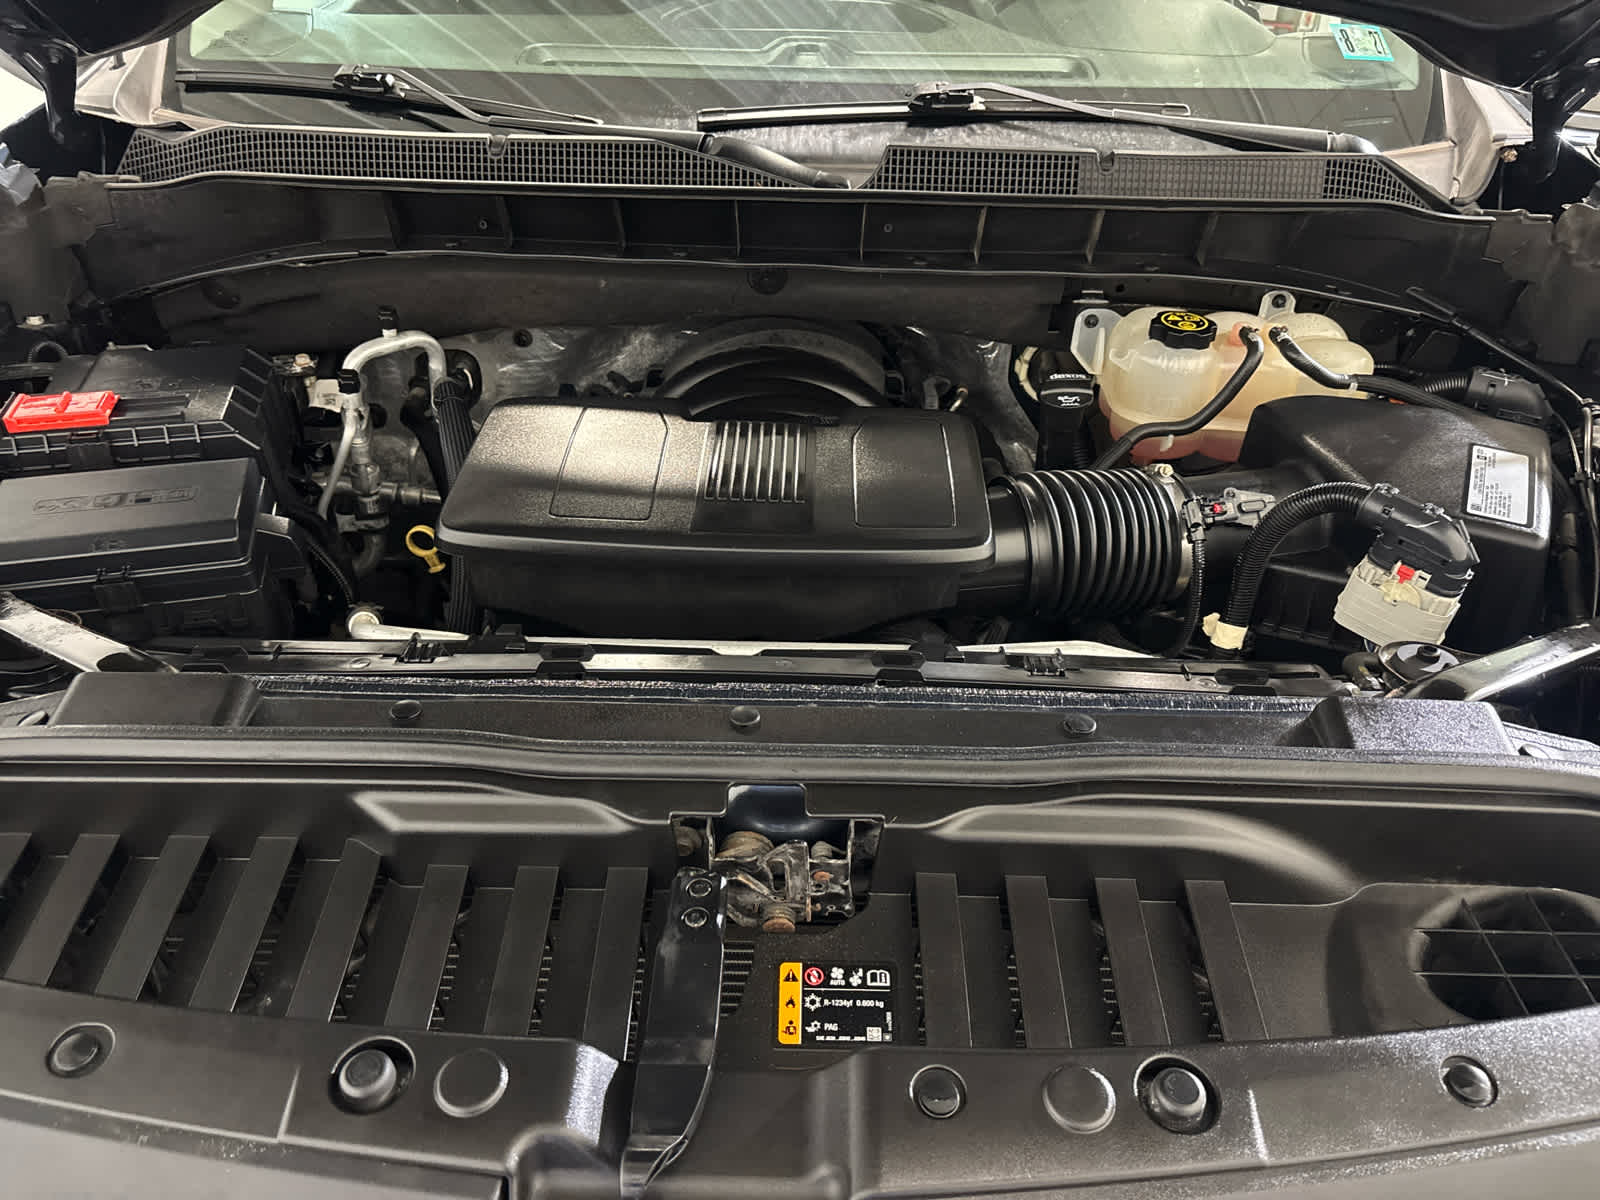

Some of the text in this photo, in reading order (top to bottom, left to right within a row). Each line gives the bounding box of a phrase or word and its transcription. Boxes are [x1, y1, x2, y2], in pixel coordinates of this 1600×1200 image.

[1339, 29, 1355, 53] 8
[875, 1000, 884, 1009] kg
[824, 1023, 838, 1031] PAG
